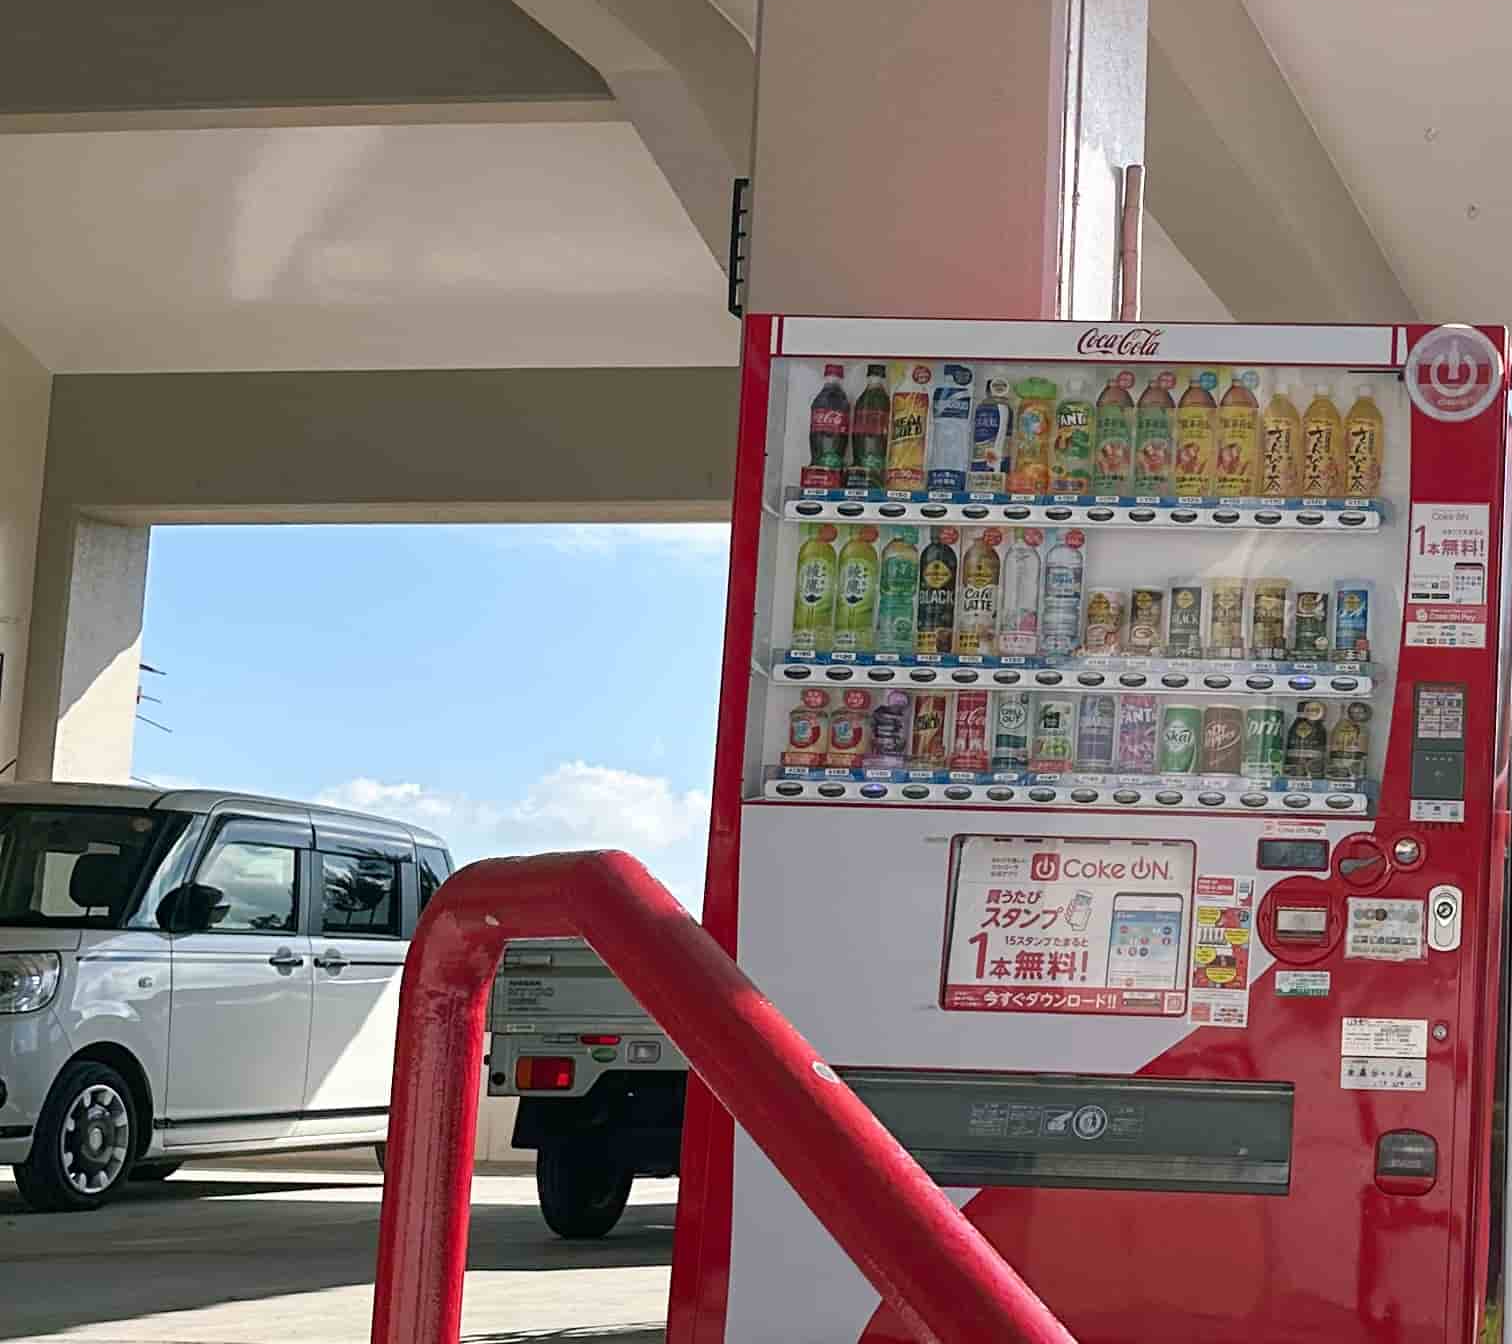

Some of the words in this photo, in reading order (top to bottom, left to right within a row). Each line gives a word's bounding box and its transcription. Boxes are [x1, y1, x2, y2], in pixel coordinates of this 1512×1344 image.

[1062, 858, 1126, 880] Coke
[985, 888, 1042, 905] 買うたび
[980, 906, 1065, 931] スタンプ
